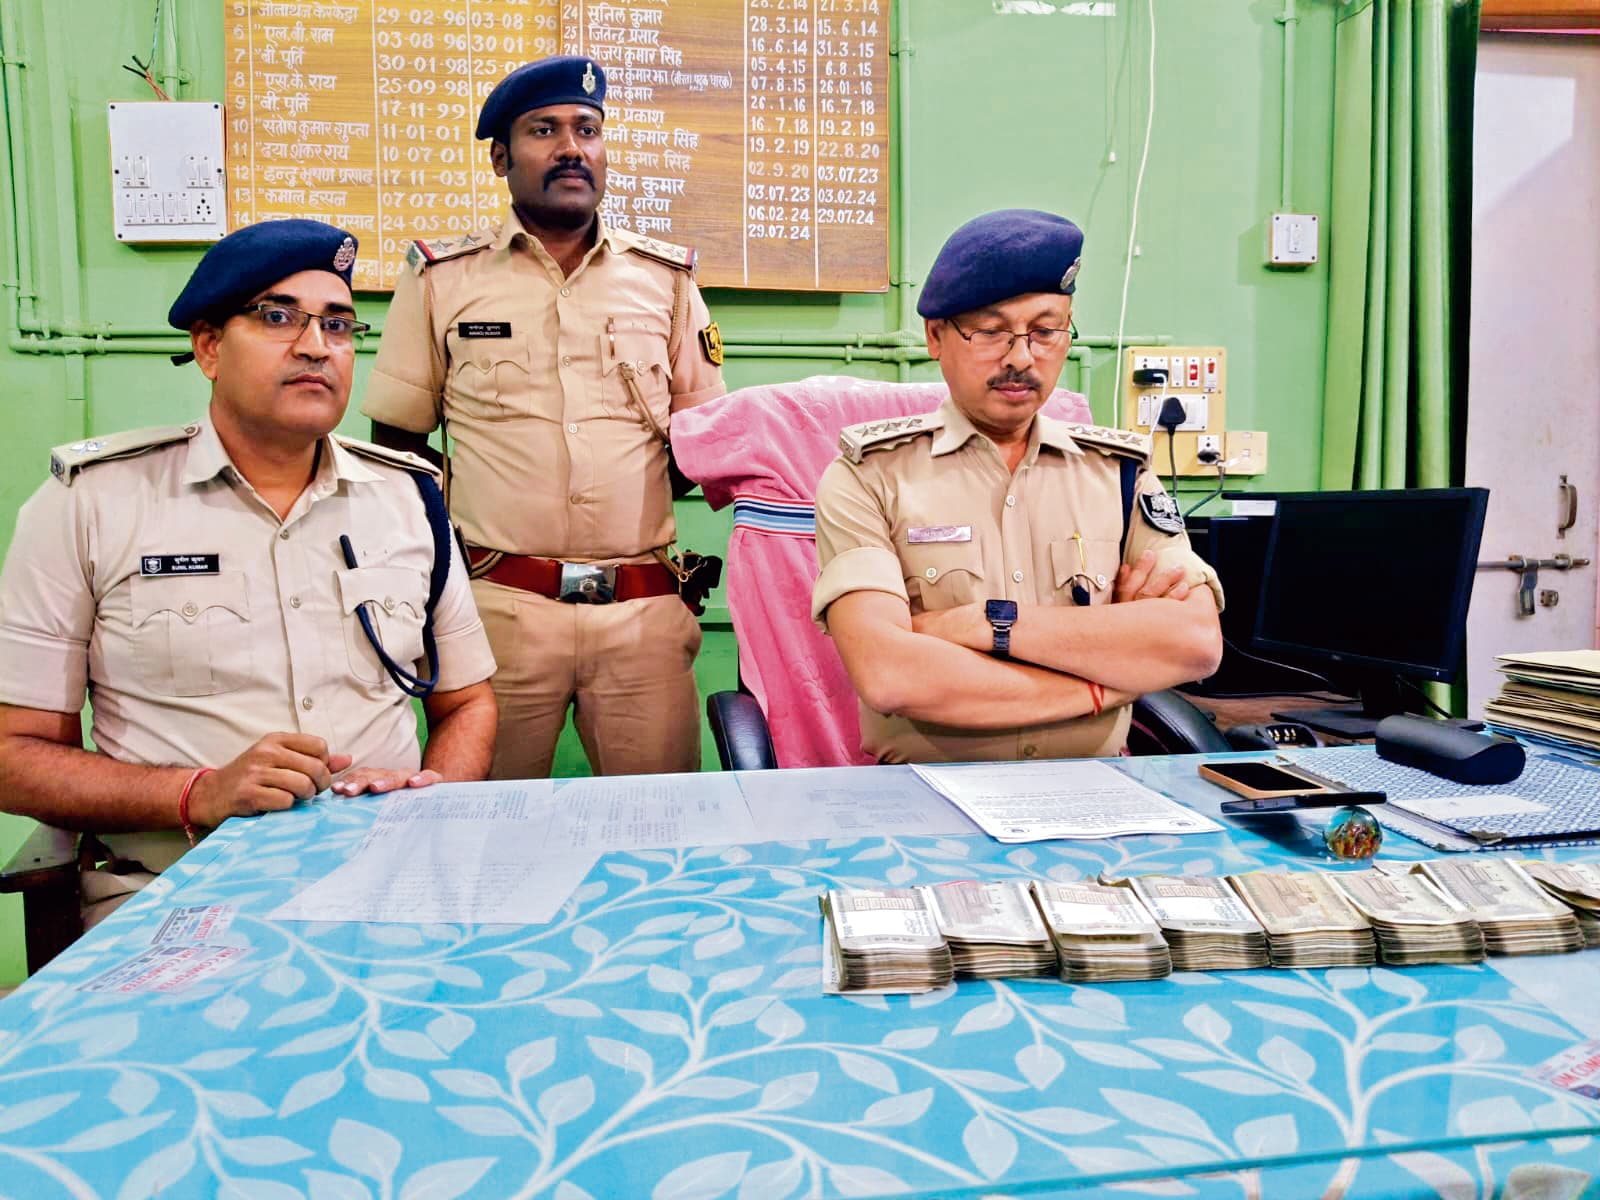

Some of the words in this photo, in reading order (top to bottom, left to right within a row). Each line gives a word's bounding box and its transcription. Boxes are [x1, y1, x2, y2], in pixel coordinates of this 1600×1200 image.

[563, 5, 579, 20] 24
[629, 8, 663, 29] कुमार
[563, 26, 578, 40] 25
[629, 28, 660, 47] प्रसाद
[234, 48, 246, 63] 7
[624, 47, 657, 67] कुमार
[660, 45, 683, 68] सिंह
[233, 72, 245, 88] 8
[234, 95, 247, 110] 9
[624, 86, 654, 105] कुमार
[233, 118, 248, 133] 10
[299, 120, 332, 141] कुमार
[233, 142, 248, 156] 11
[631, 128, 670, 149] कुमार
[673, 128, 700, 152] सिंह
[235, 165, 249, 180] 12
[624, 150, 660, 172] कुमार
[817, 166, 879, 184] 03.07.23
[235, 187, 251, 203] 13
[640, 176, 687, 197] कुमार
[818, 188, 877, 206] 03.02.24
[234, 211, 251, 227] 14
[635, 214, 673, 235] कुमार
[817, 207, 875, 226] 29.07.24
